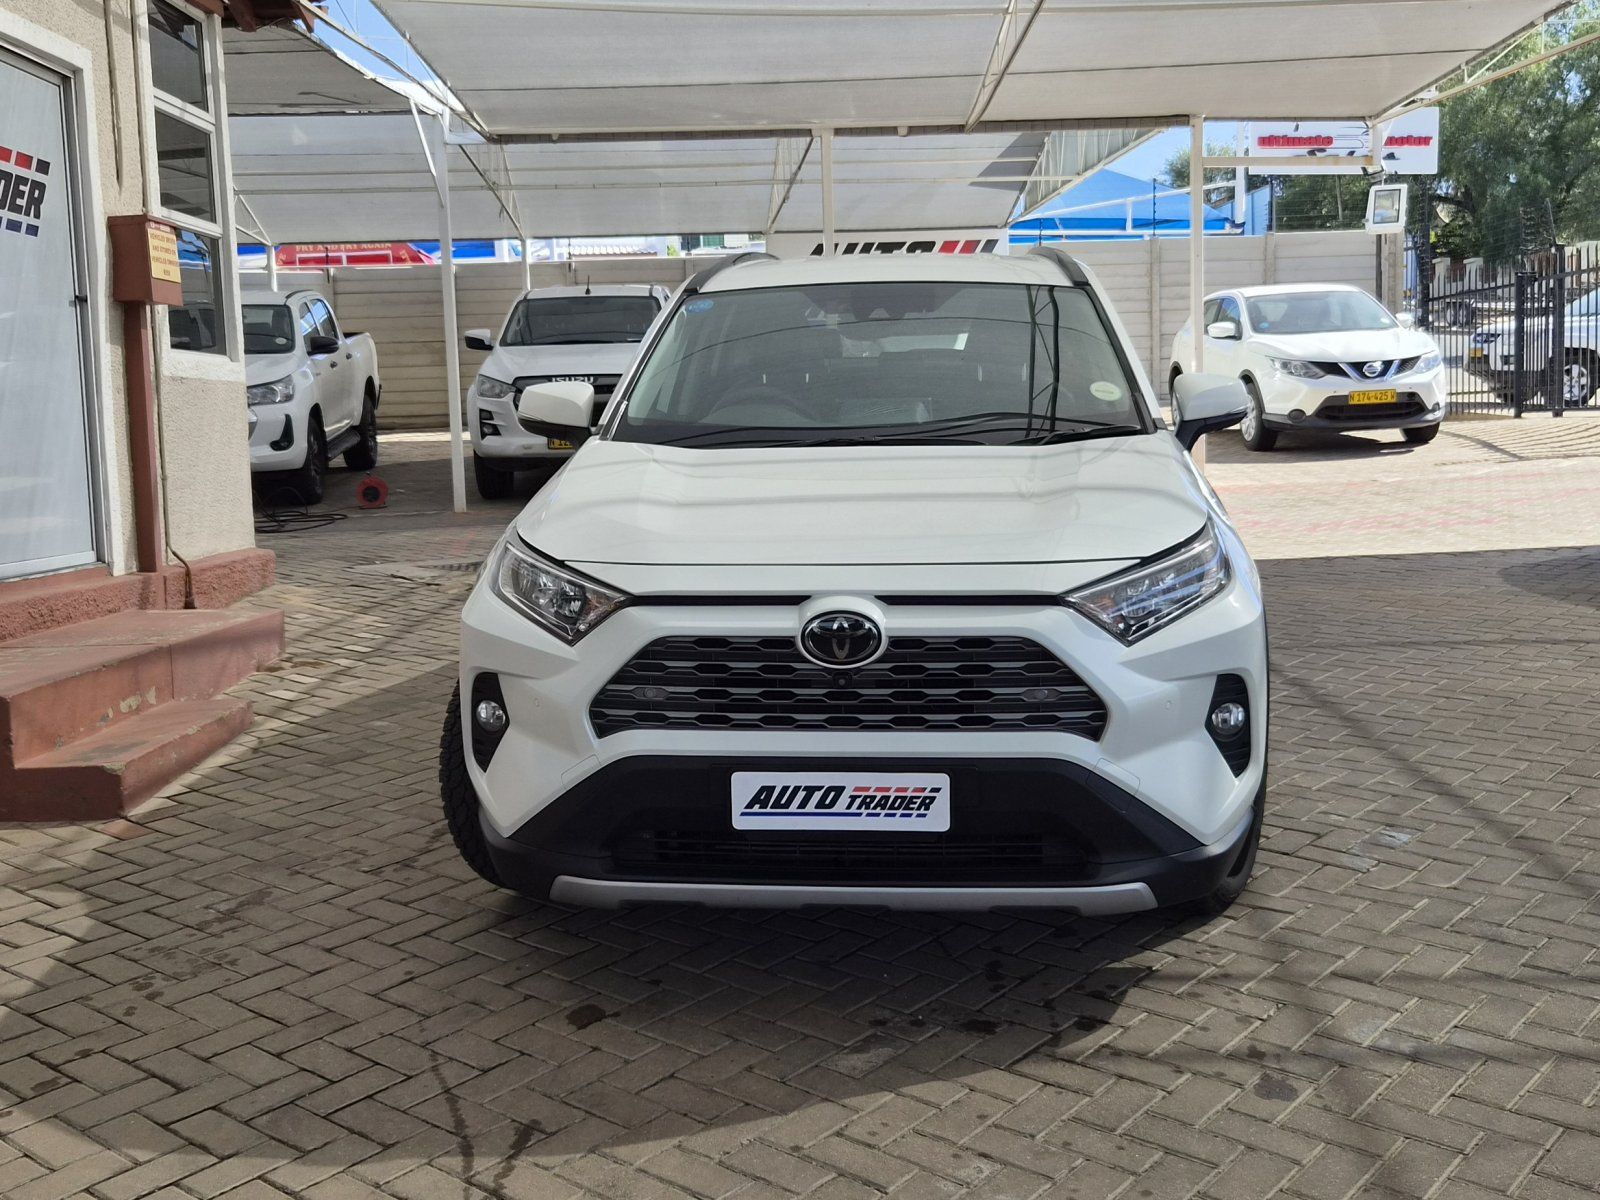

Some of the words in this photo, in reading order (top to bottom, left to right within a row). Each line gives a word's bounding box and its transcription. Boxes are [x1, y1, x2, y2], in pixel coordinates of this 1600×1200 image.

[1257, 135, 1334, 147] ultimate
[744, 785, 846, 810] AUTO
[845, 795, 937, 811] TRADER
